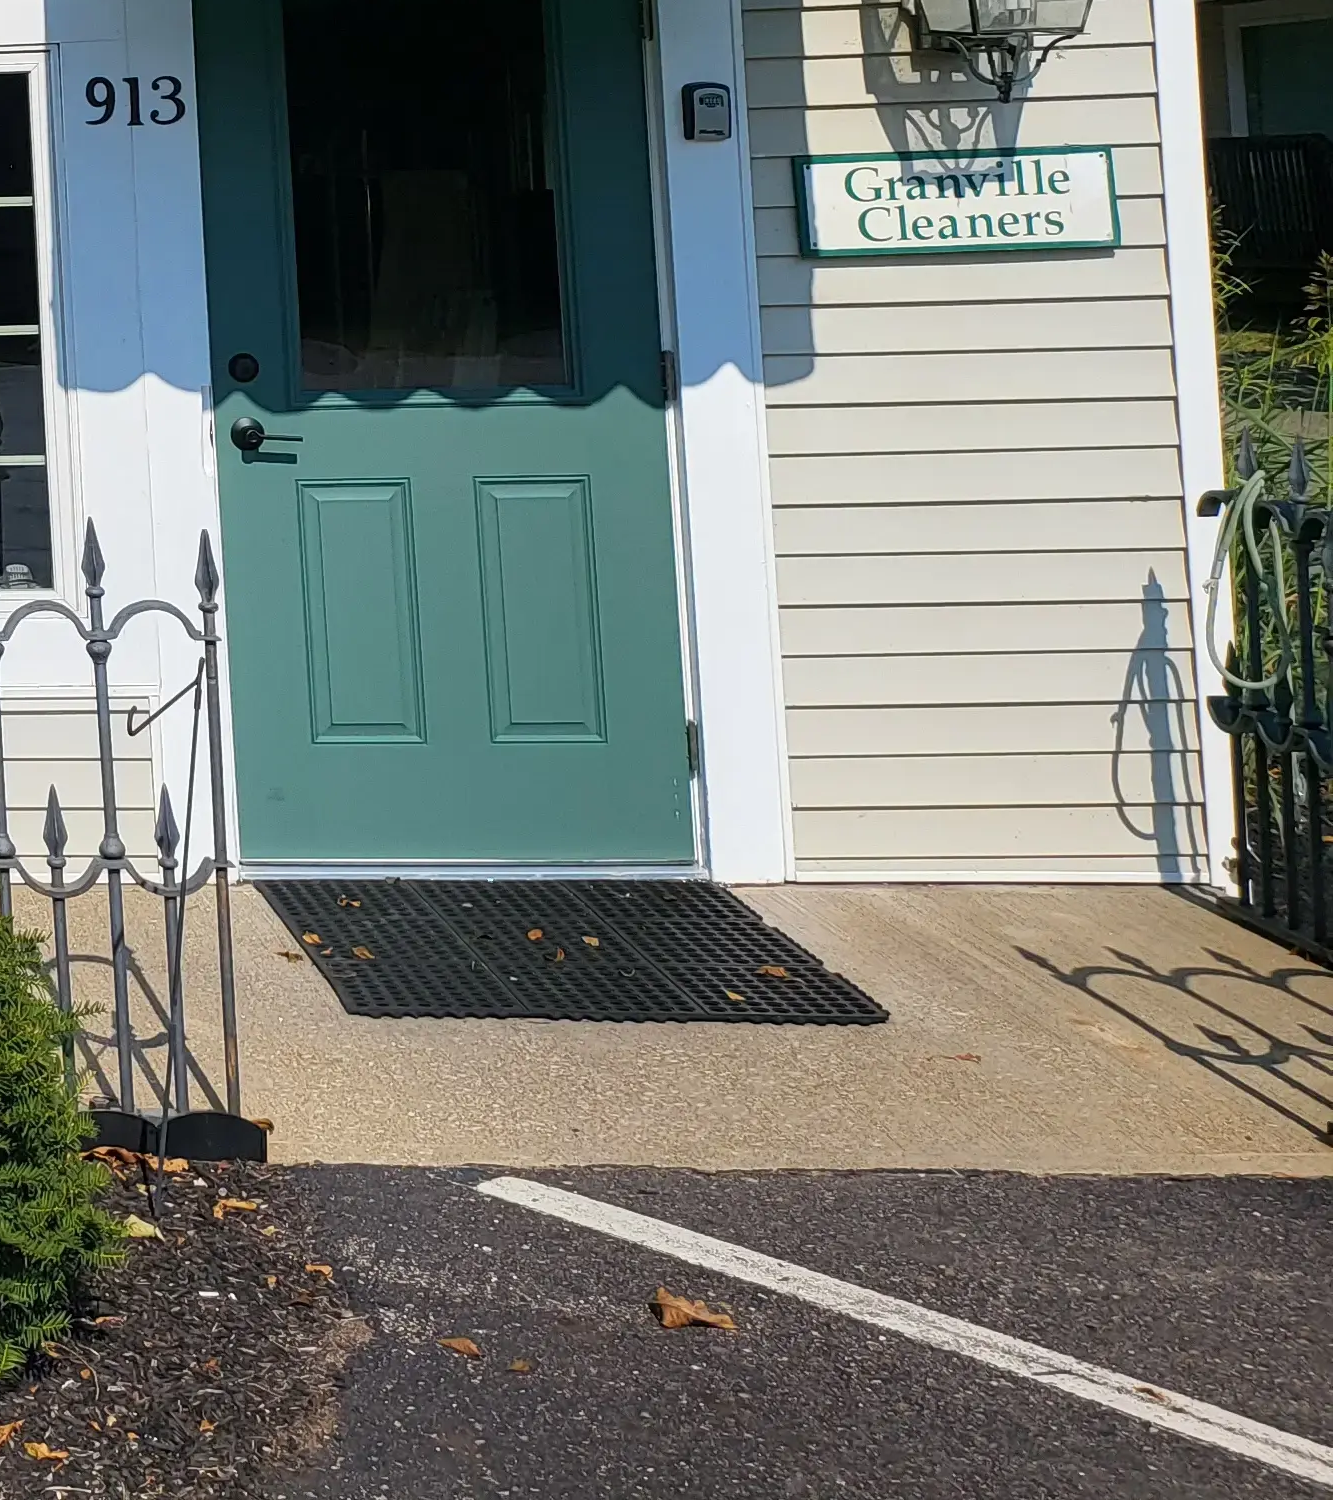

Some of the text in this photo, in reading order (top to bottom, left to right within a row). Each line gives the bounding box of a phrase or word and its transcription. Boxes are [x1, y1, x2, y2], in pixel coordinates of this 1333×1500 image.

[85, 75, 186, 126] 913
[844, 158, 1070, 242] Granville Cleaners
